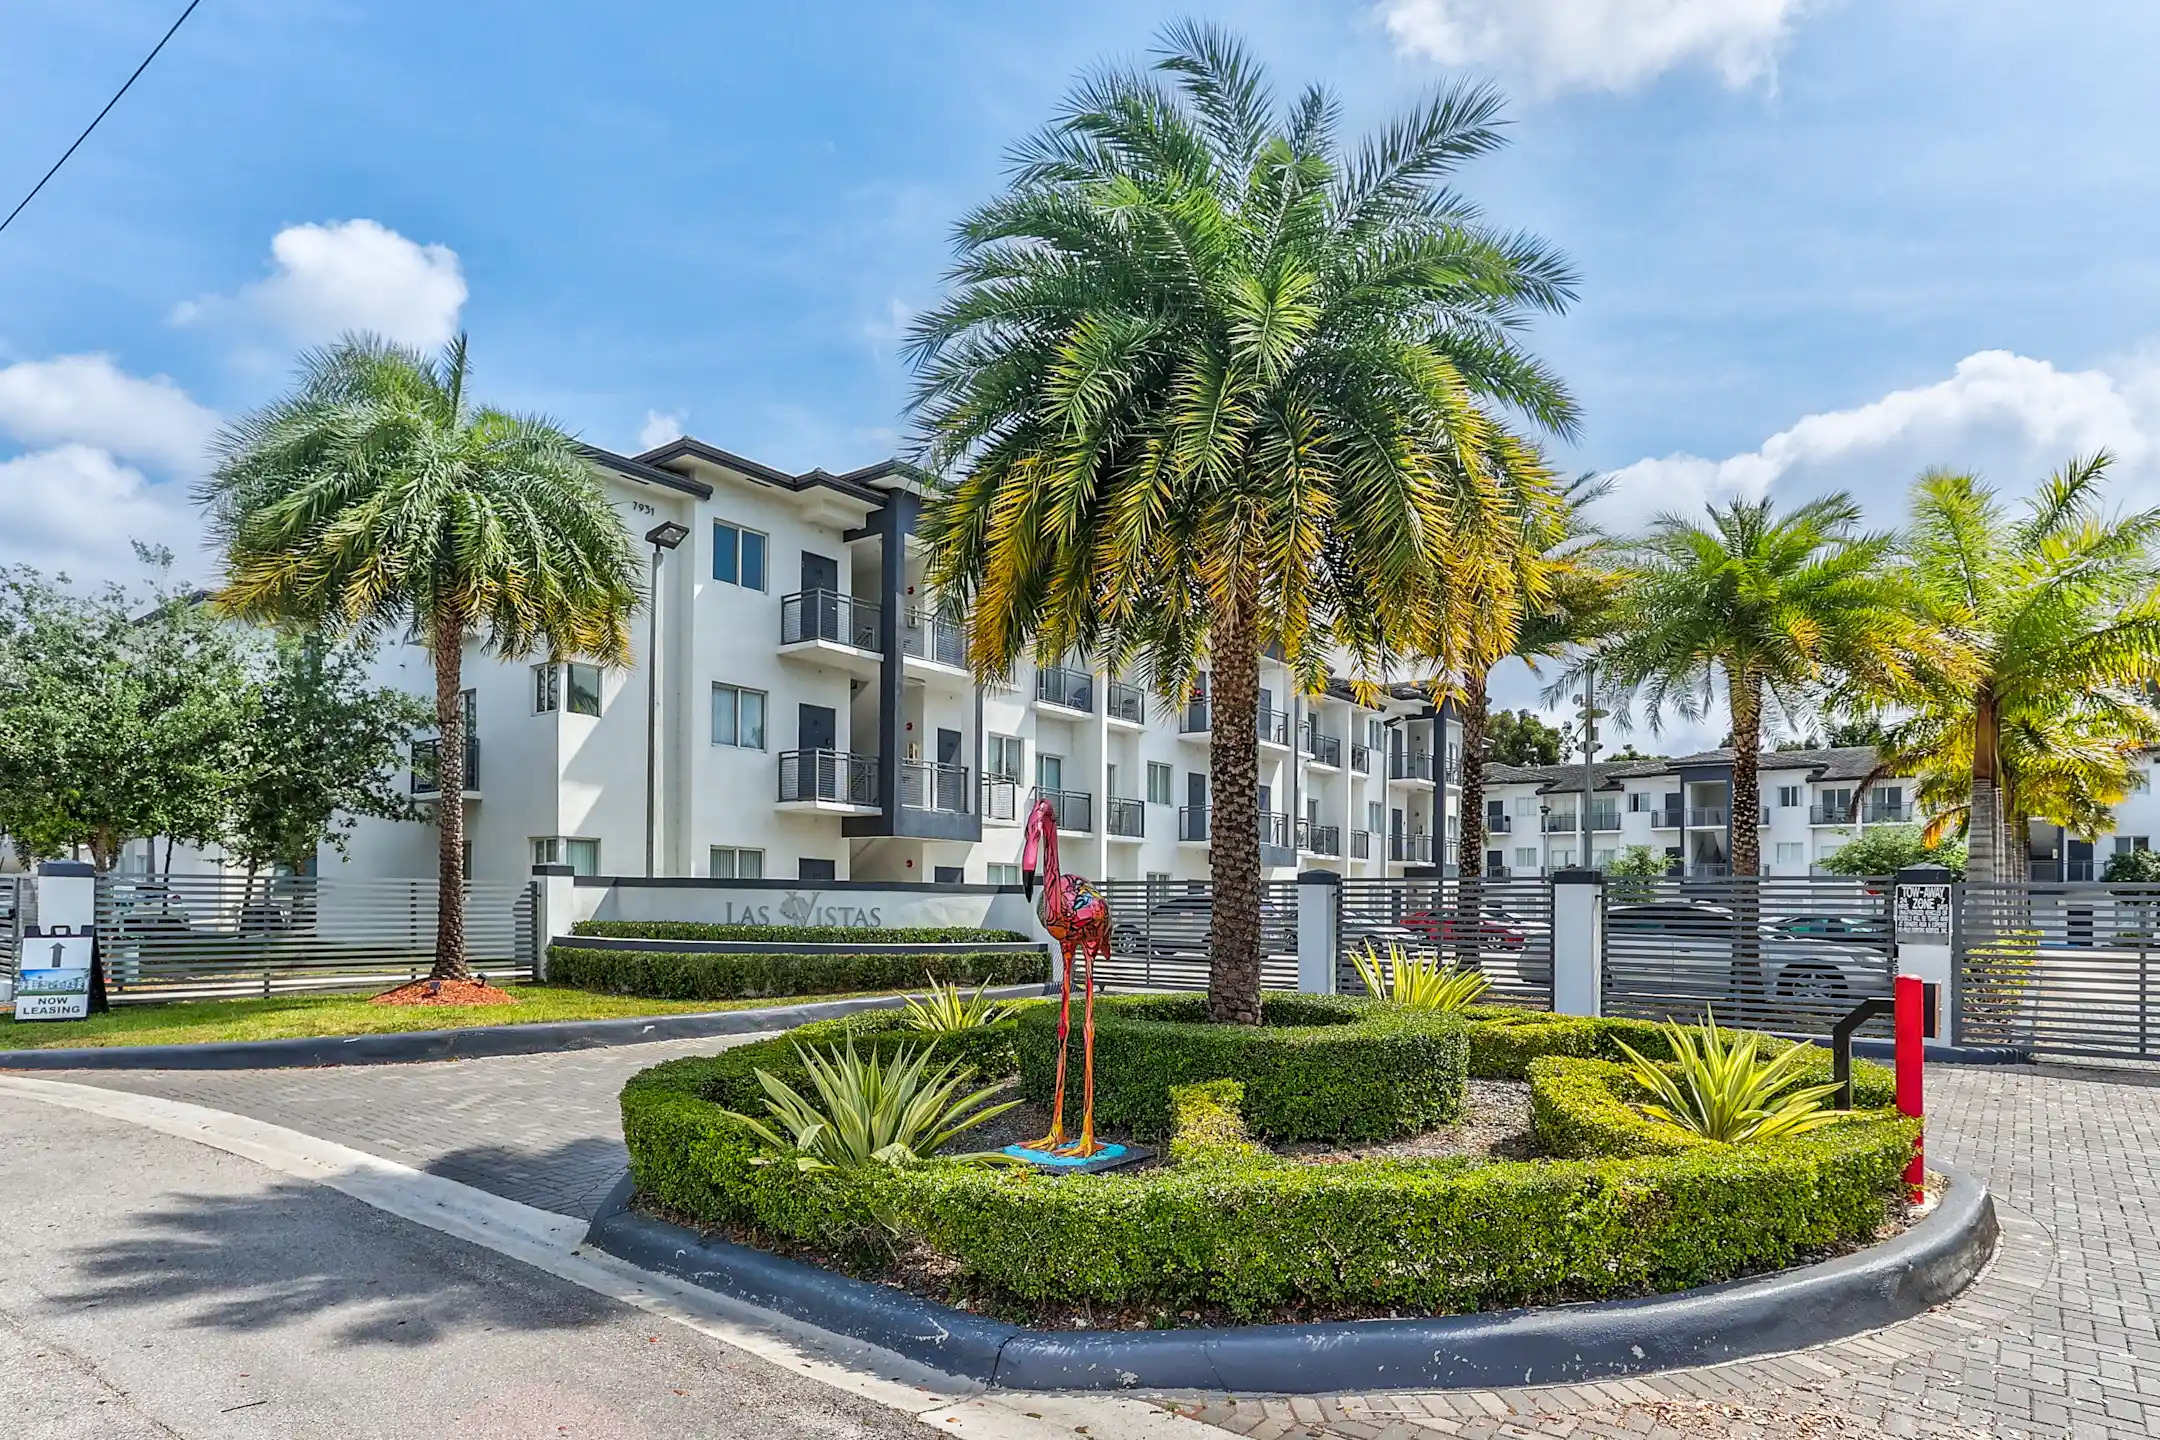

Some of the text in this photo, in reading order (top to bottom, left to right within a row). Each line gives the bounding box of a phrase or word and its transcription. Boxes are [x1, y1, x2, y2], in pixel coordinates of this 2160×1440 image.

[633, 501, 654, 516] 7931
[1902, 886, 1945, 898] TOW-AWAY
[1912, 898, 1935, 909] ZONE
[726, 892, 881, 927] LAS VISTAS
[38, 997, 68, 1005] NOW
[23, 1005, 80, 1015] LEASING
